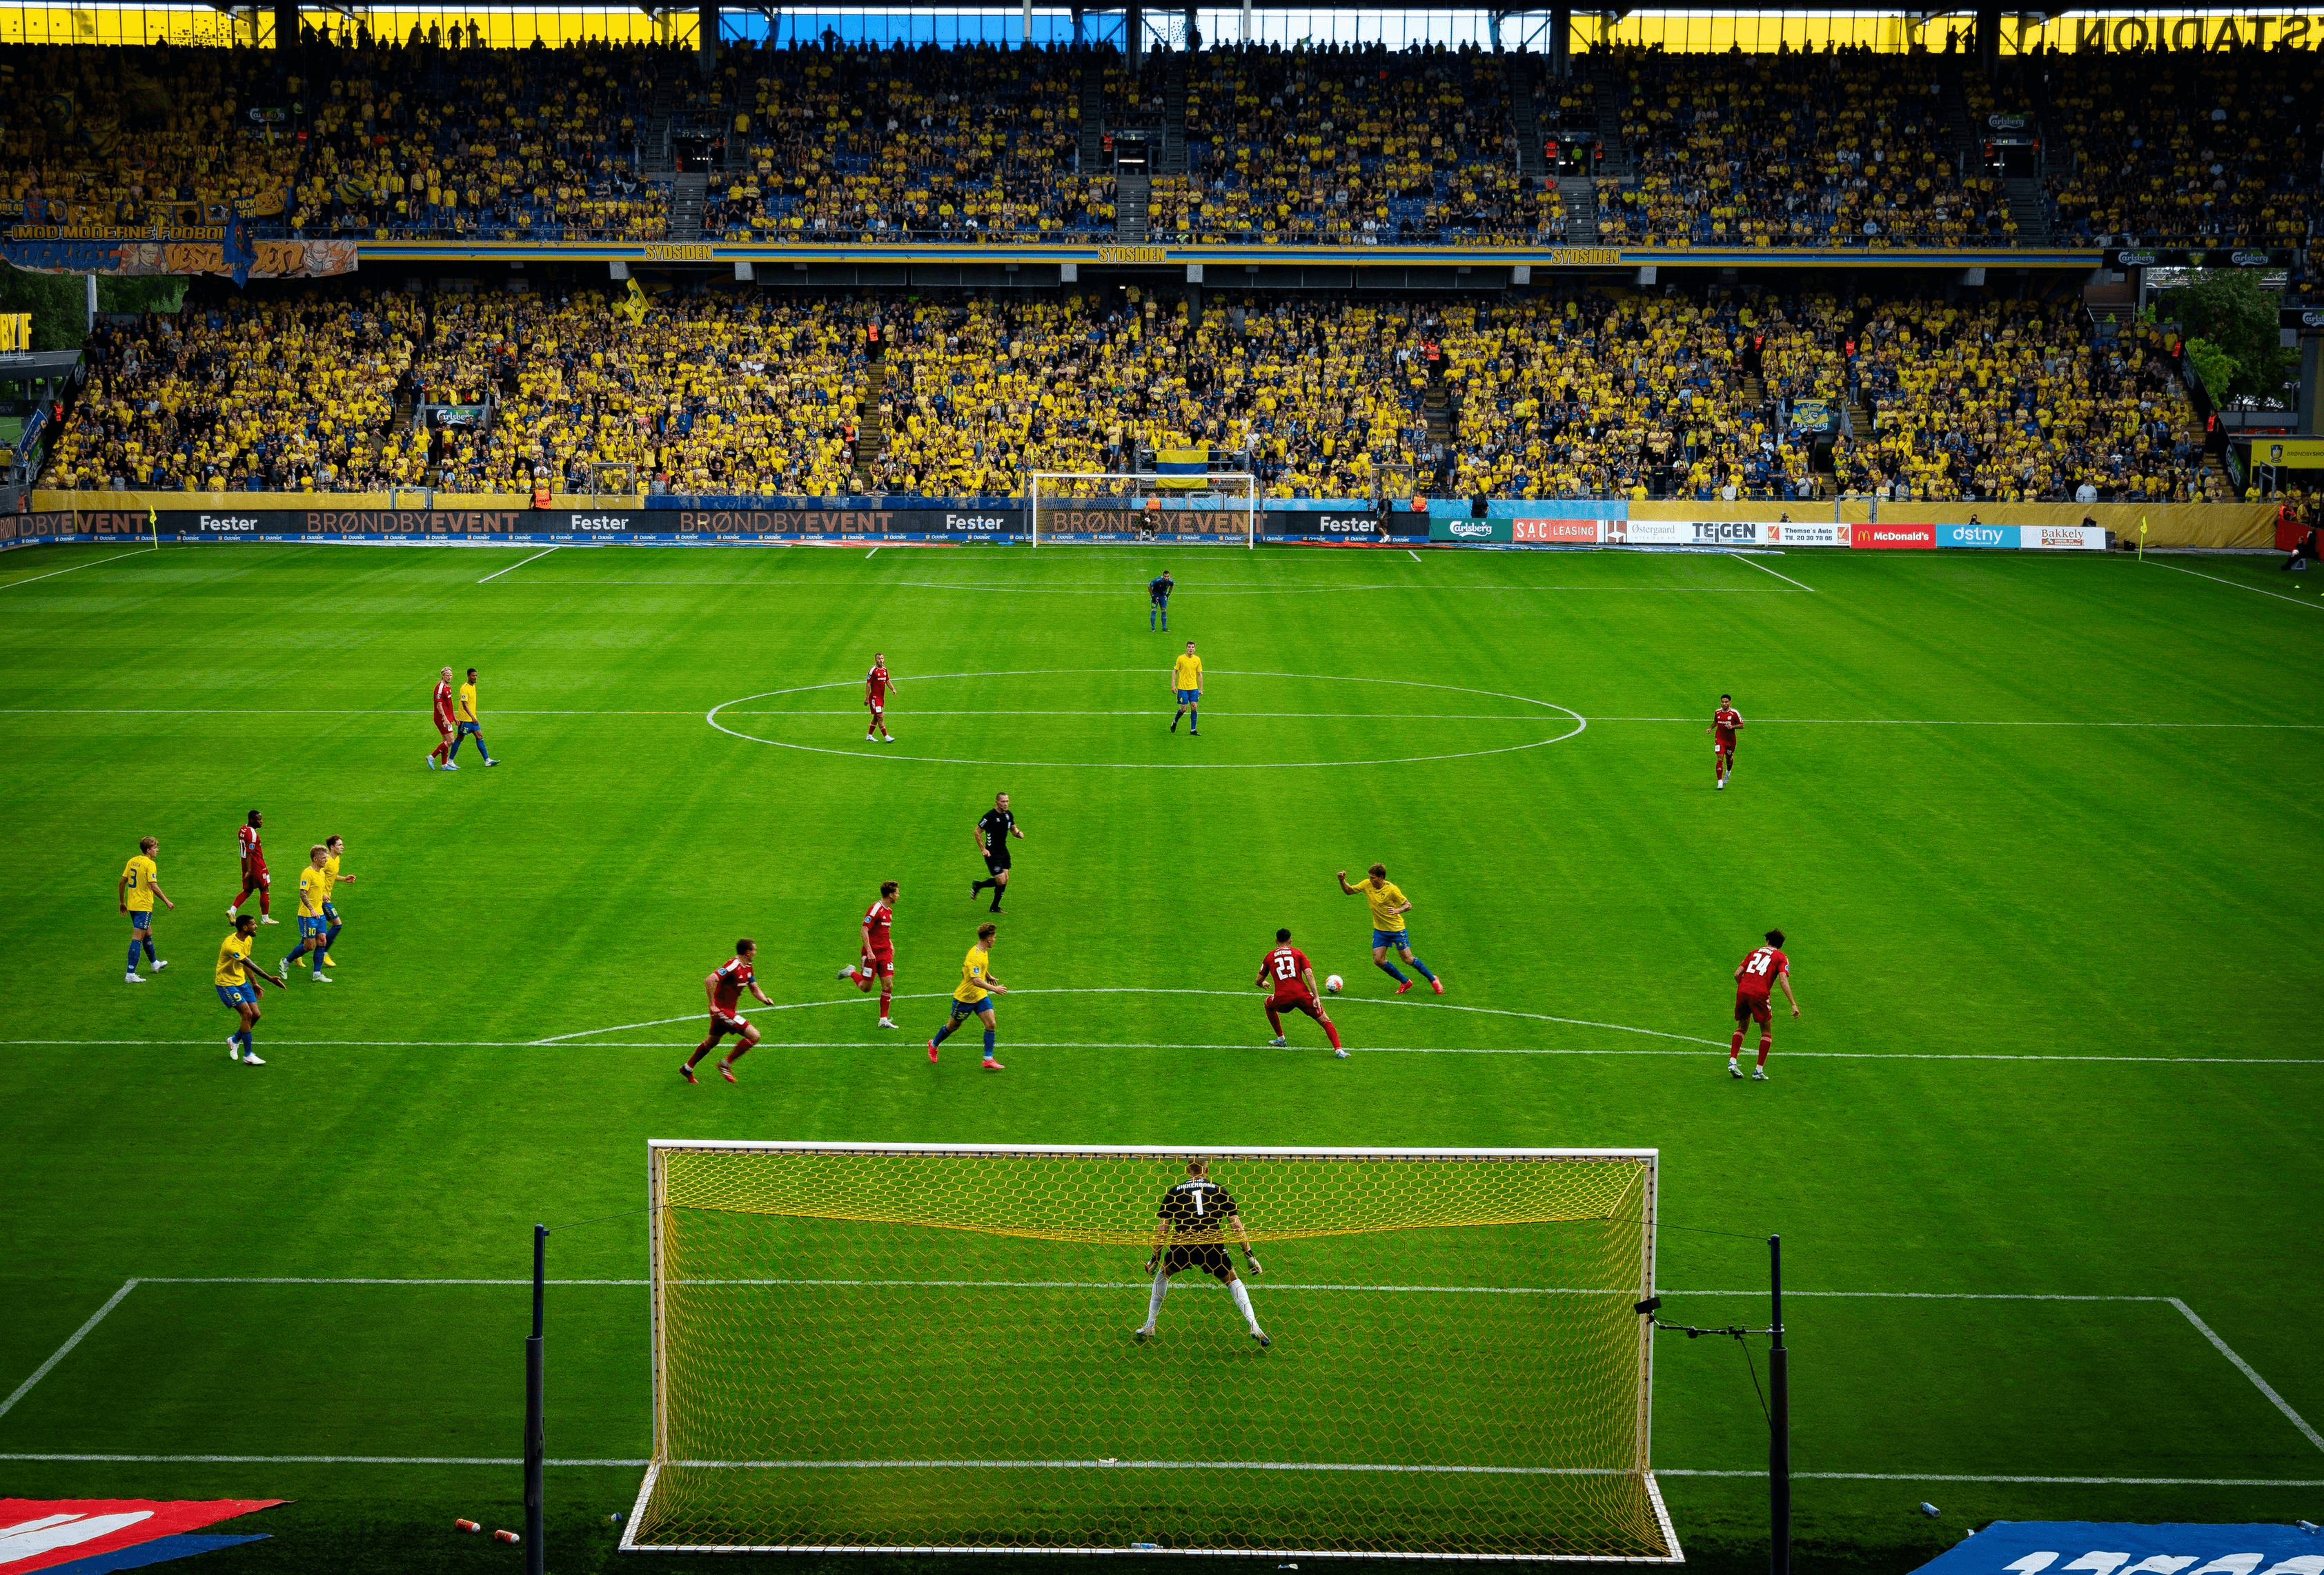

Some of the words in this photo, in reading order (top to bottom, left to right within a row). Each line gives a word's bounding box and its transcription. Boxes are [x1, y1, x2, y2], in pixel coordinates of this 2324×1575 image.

[1989, 115, 2025, 130] Carlsberg
[235, 198, 256, 209] FUCK
[12, 226, 60, 239] IMOD
[62, 226, 153, 239] MODERNE
[645, 244, 713, 261] SYDSIDEN
[1099, 246, 1166, 263] SYDSIDEN
[1552, 248, 1620, 264] SYDSIDEN
[2118, 251, 2155, 265] Carlsberg
[2232, 251, 2269, 265] Carlsberg
[18, 313, 32, 351] IF
[200, 516, 257, 531] Fester
[307, 511, 520, 533] BRØNDBYEVENT
[571, 515, 629, 530] Fester
[680, 511, 894, 532] BRØNDBYEVENT
[946, 514, 1004, 530] Fester
[1320, 516, 1377, 532] Fester
[1449, 520, 1493, 537] Carlsberg
[1632, 524, 1675, 535] Østergaard
[1516, 522, 1547, 538] SAC
[1553, 526, 1595, 536] LEASING
[1873, 531, 1930, 540] McDonald's
[1953, 527, 2004, 545] dstny
[2042, 529, 2084, 542] Bakkely
[128, 868, 137, 888] 3
[308, 927, 317, 937] 10
[1274, 956, 1297, 980] 23
[1746, 952, 1771, 976] 24
[233, 992, 242, 1002] 9
[1192, 1189, 1204, 1215] 1
